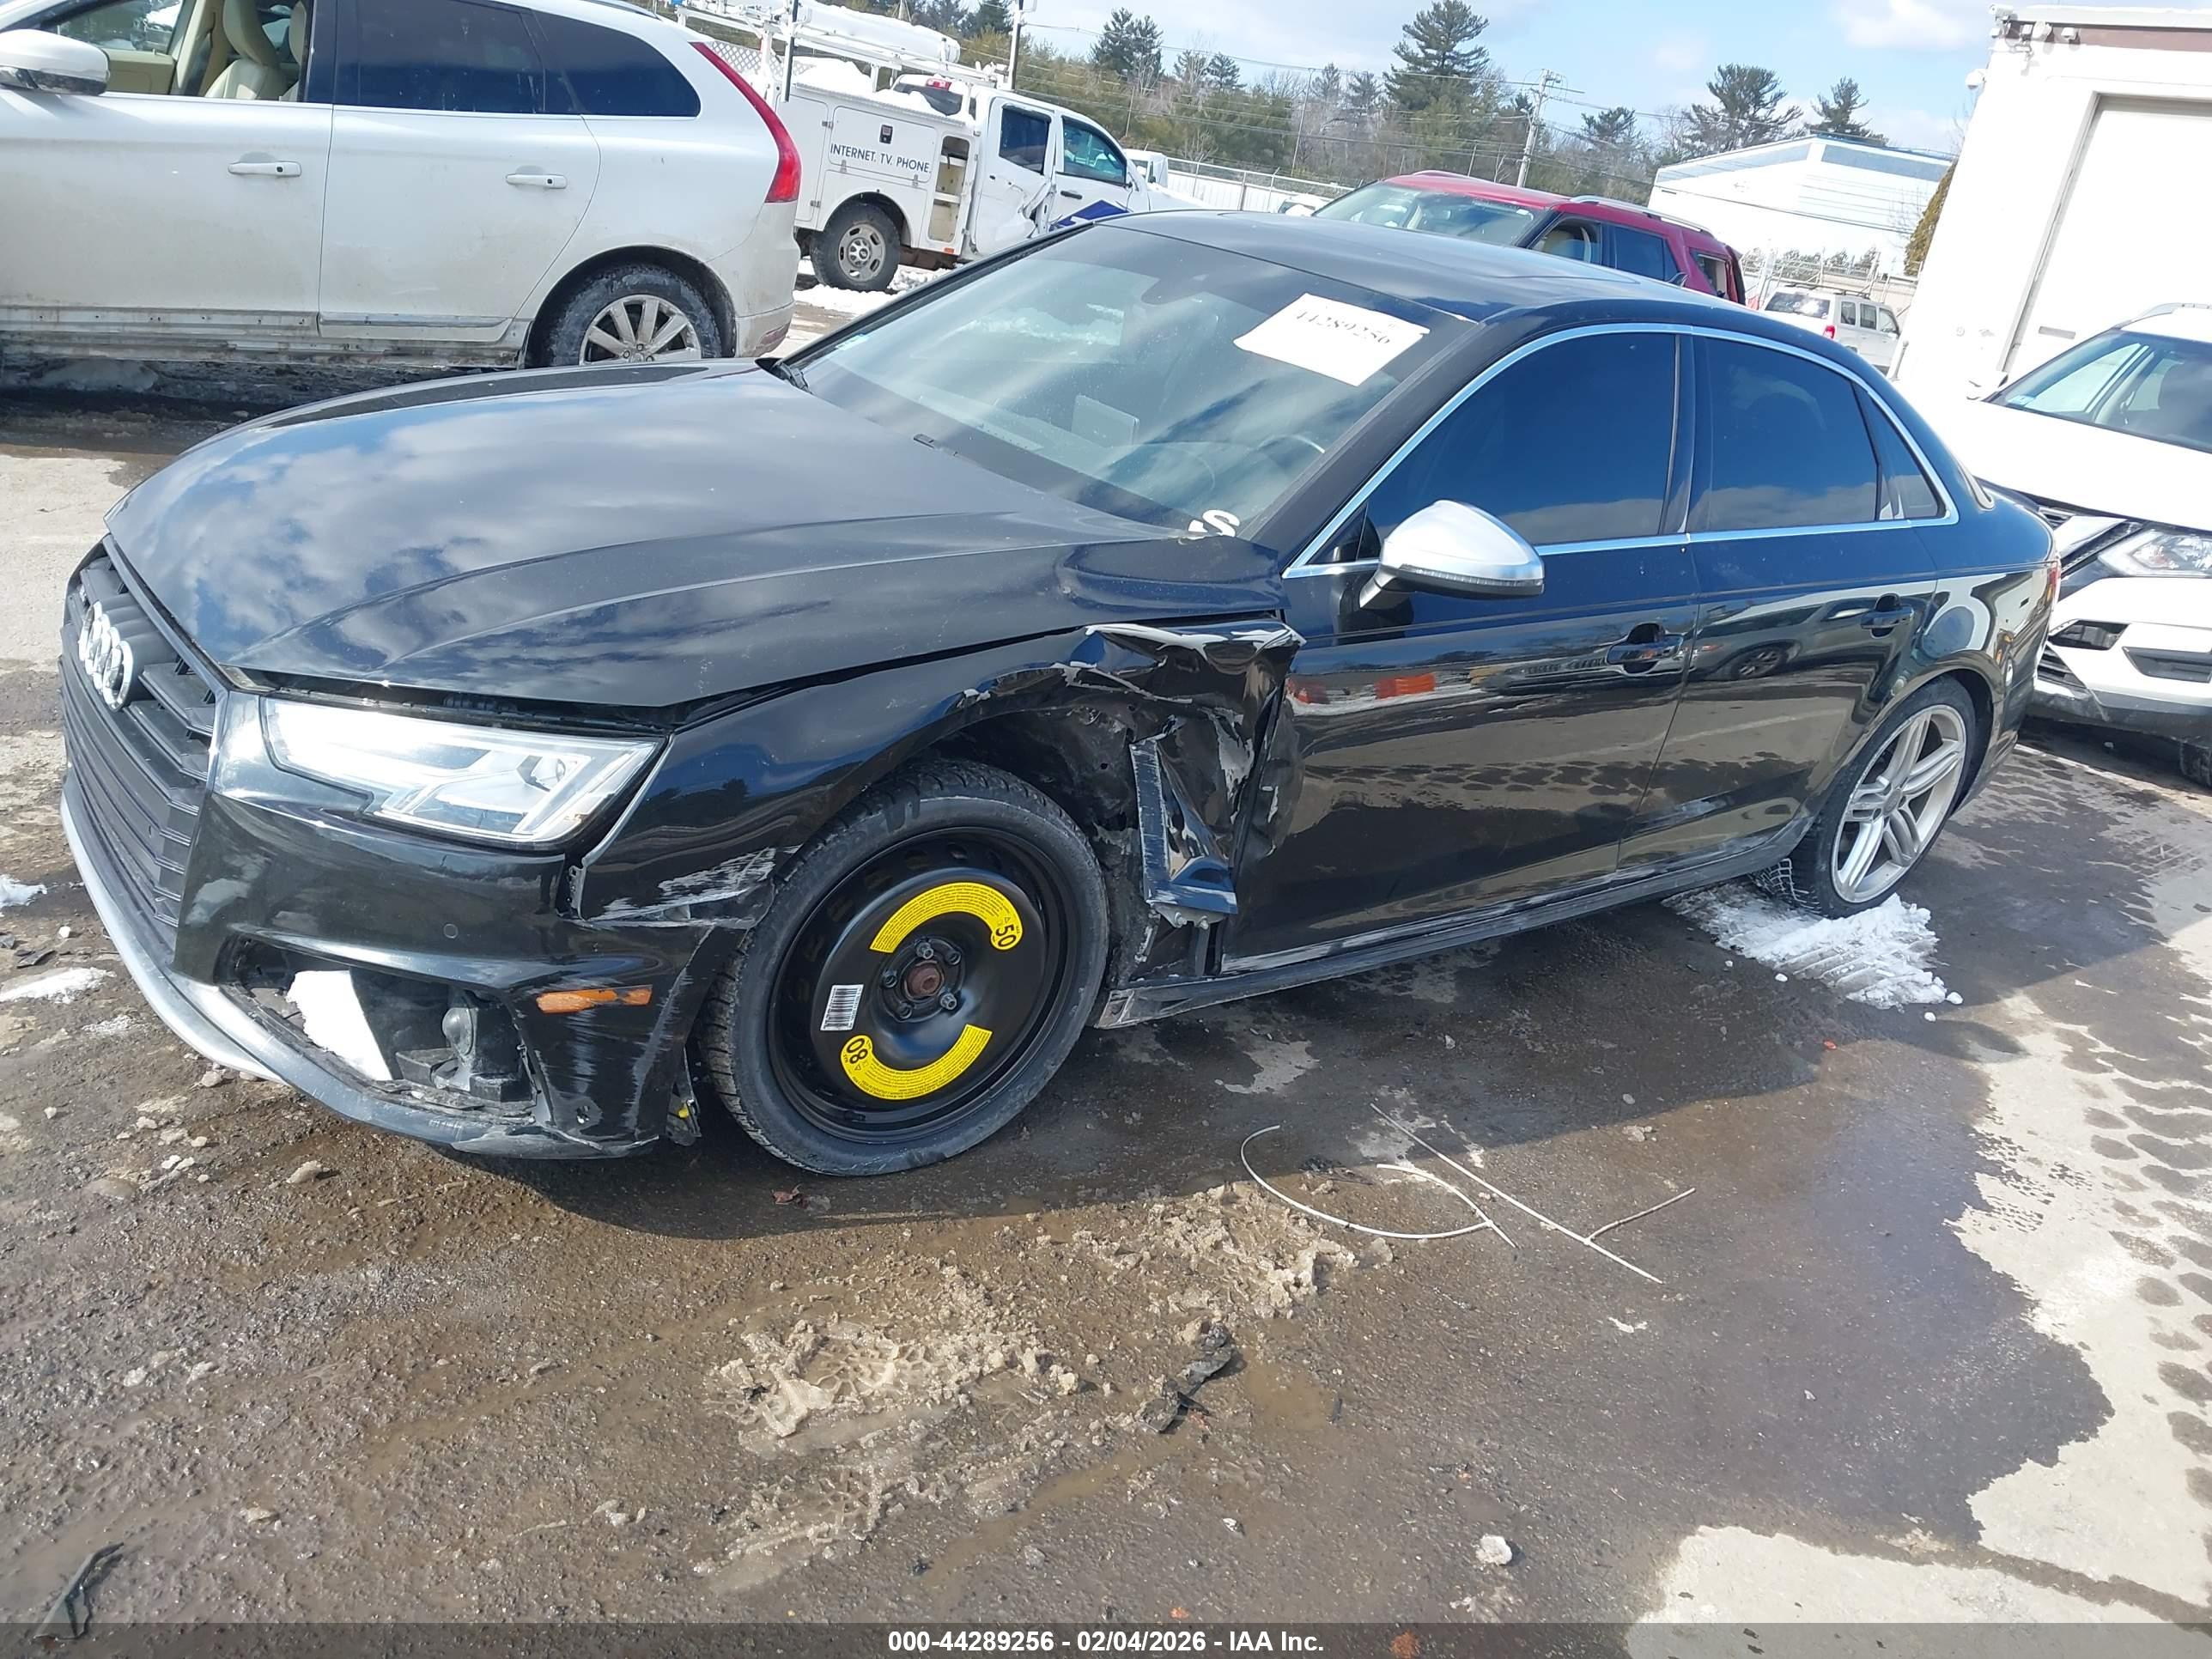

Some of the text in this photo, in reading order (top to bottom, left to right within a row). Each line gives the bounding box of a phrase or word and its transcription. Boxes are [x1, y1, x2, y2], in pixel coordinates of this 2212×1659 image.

[830, 143, 932, 173] INTERNET. TV. PHONE.
[995, 923, 1017, 947] 50
[846, 1037, 868, 1064] 80
